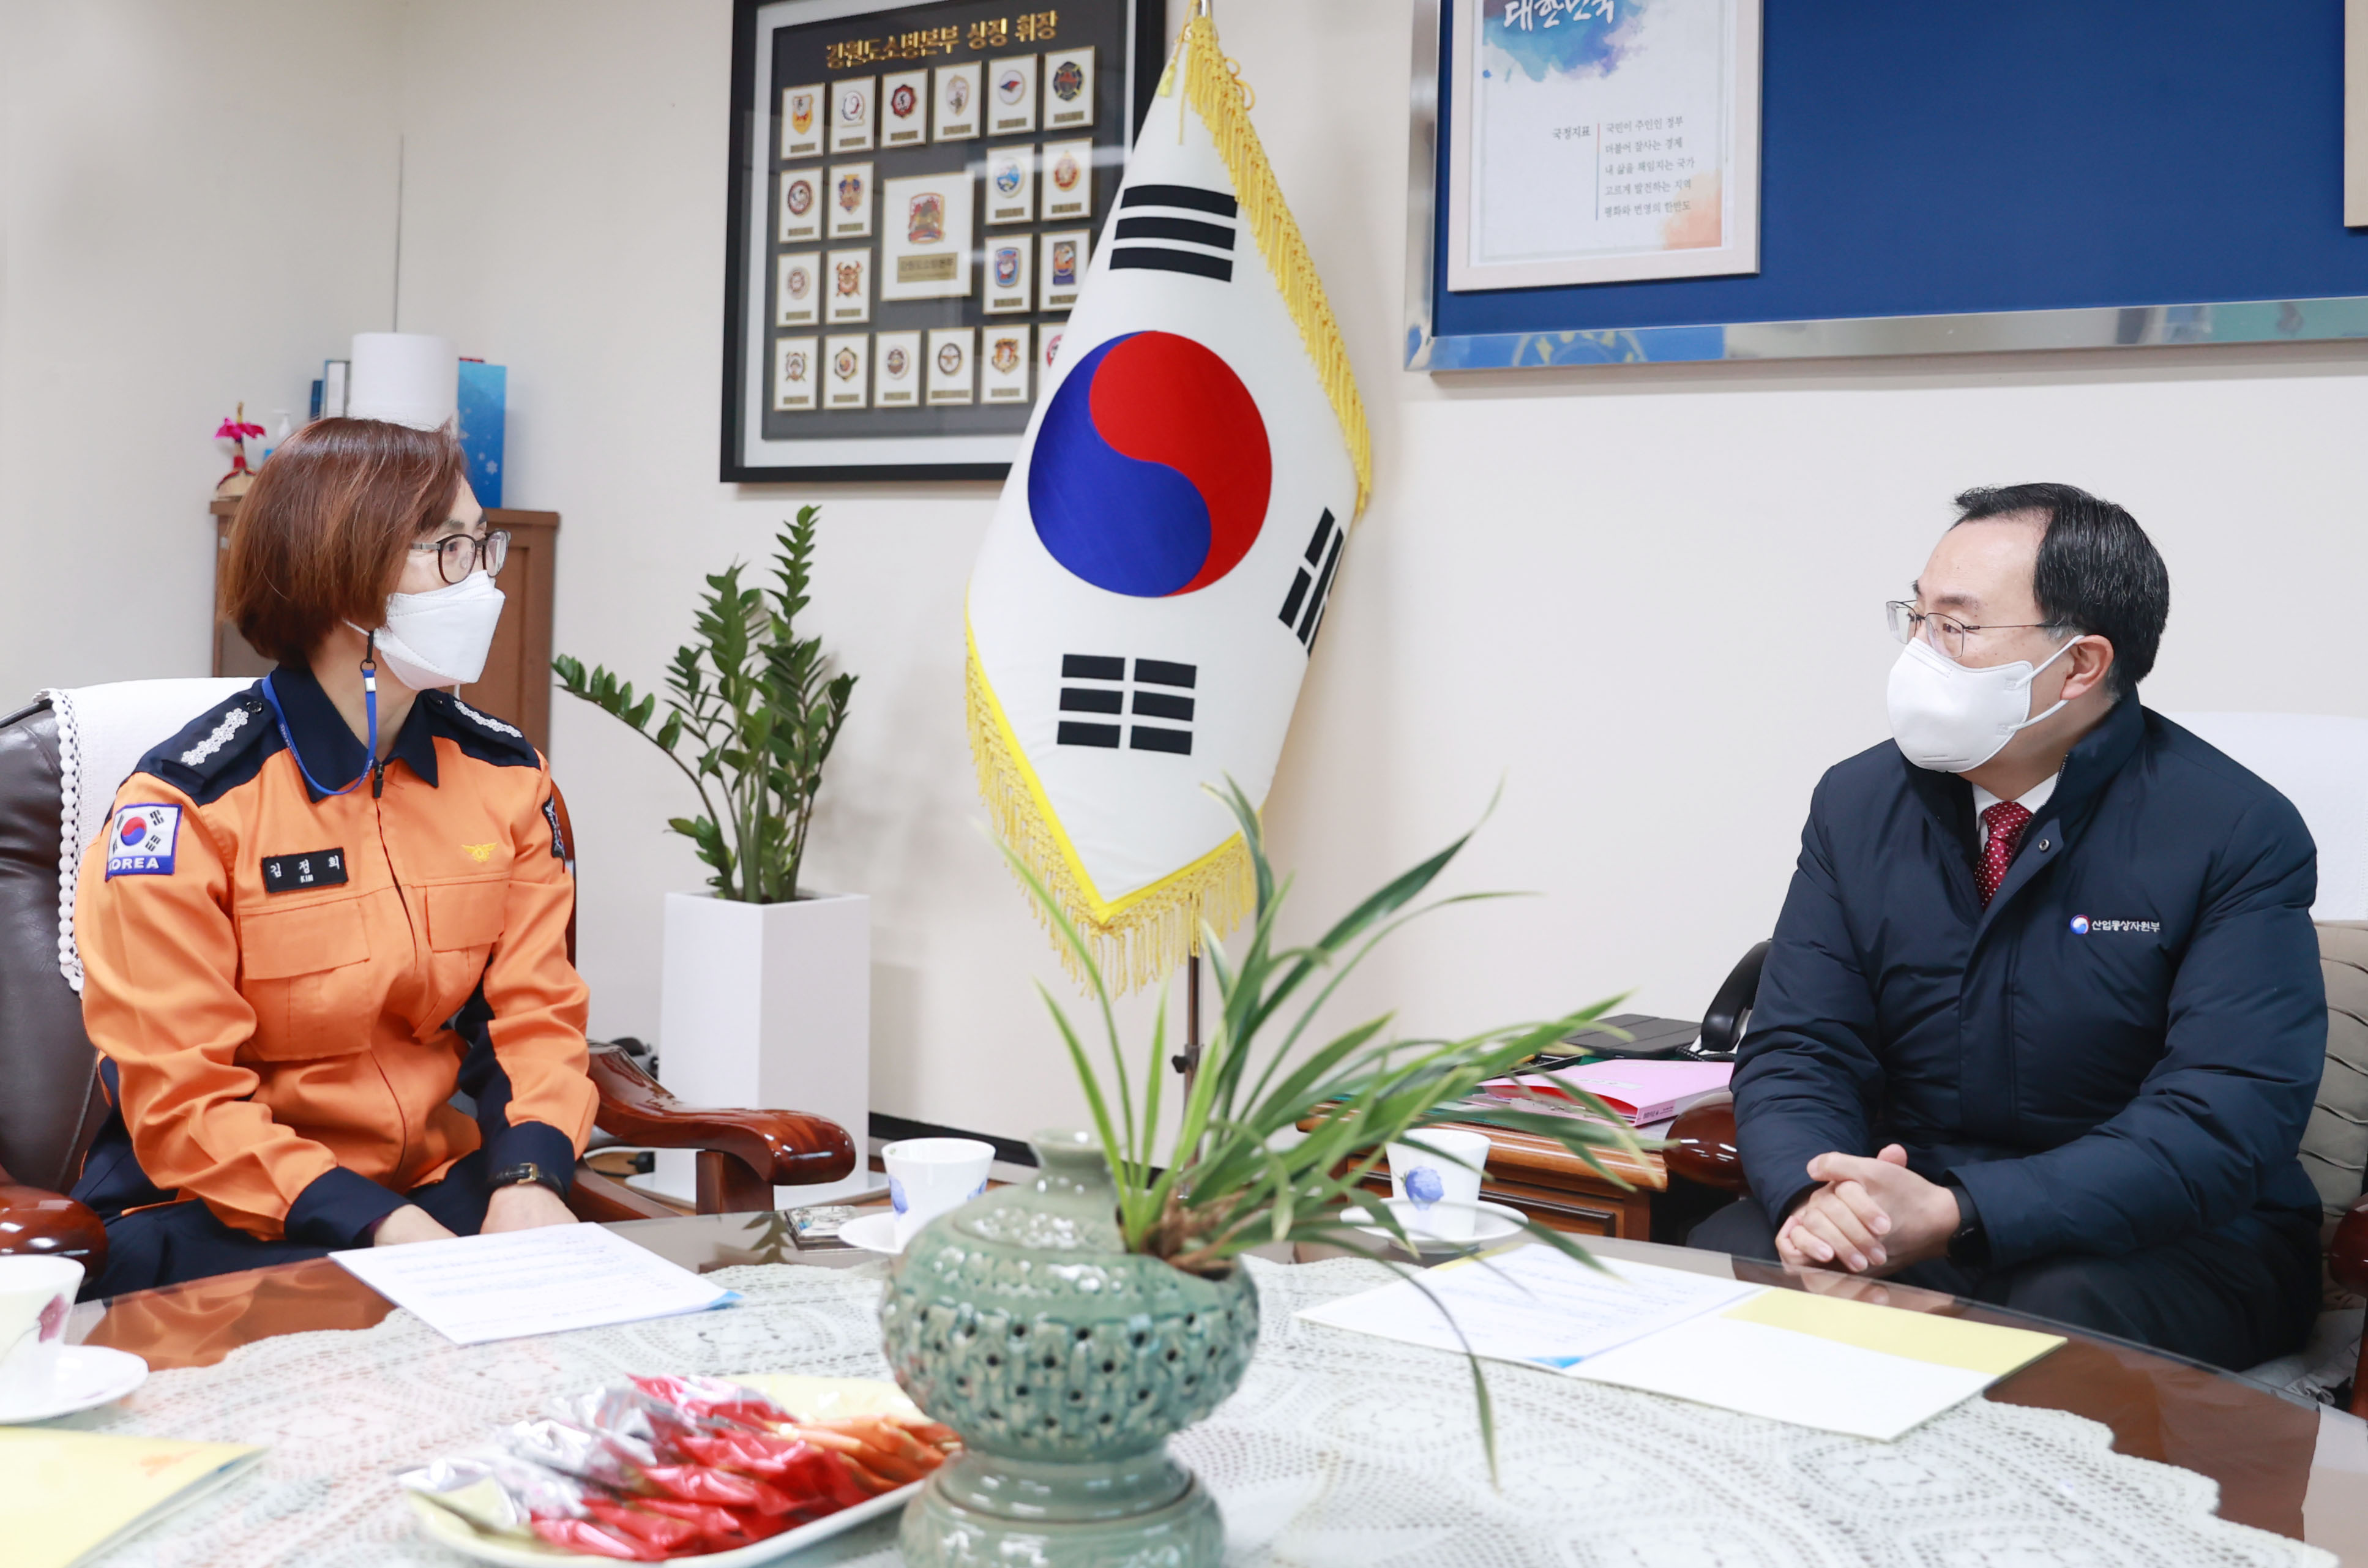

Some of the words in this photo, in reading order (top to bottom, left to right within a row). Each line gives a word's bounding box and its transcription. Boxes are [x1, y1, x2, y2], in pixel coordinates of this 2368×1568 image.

[826, 25, 959, 69] 강원도소방본부
[1015, 10, 1058, 42] 휘장
[1552, 125, 1591, 140] 국정지표
[1606, 121, 1632, 133] 국민이
[1635, 118, 1663, 131] 주인인
[1667, 116, 1684, 128] 정부
[1605, 141, 1631, 154] 더불어
[1666, 136, 1684, 149] 경제
[1605, 164, 1613, 175] 내
[1638, 159, 1675, 172] 책임지는
[1677, 157, 1695, 168] 국가
[1635, 181, 1671, 195] 발전하는
[1605, 204, 1630, 218] 평화와
[1634, 202, 1661, 215] 번영의
[1665, 200, 1691, 214] 한반도
[2091, 920, 2161, 932] 산업통상자원부
